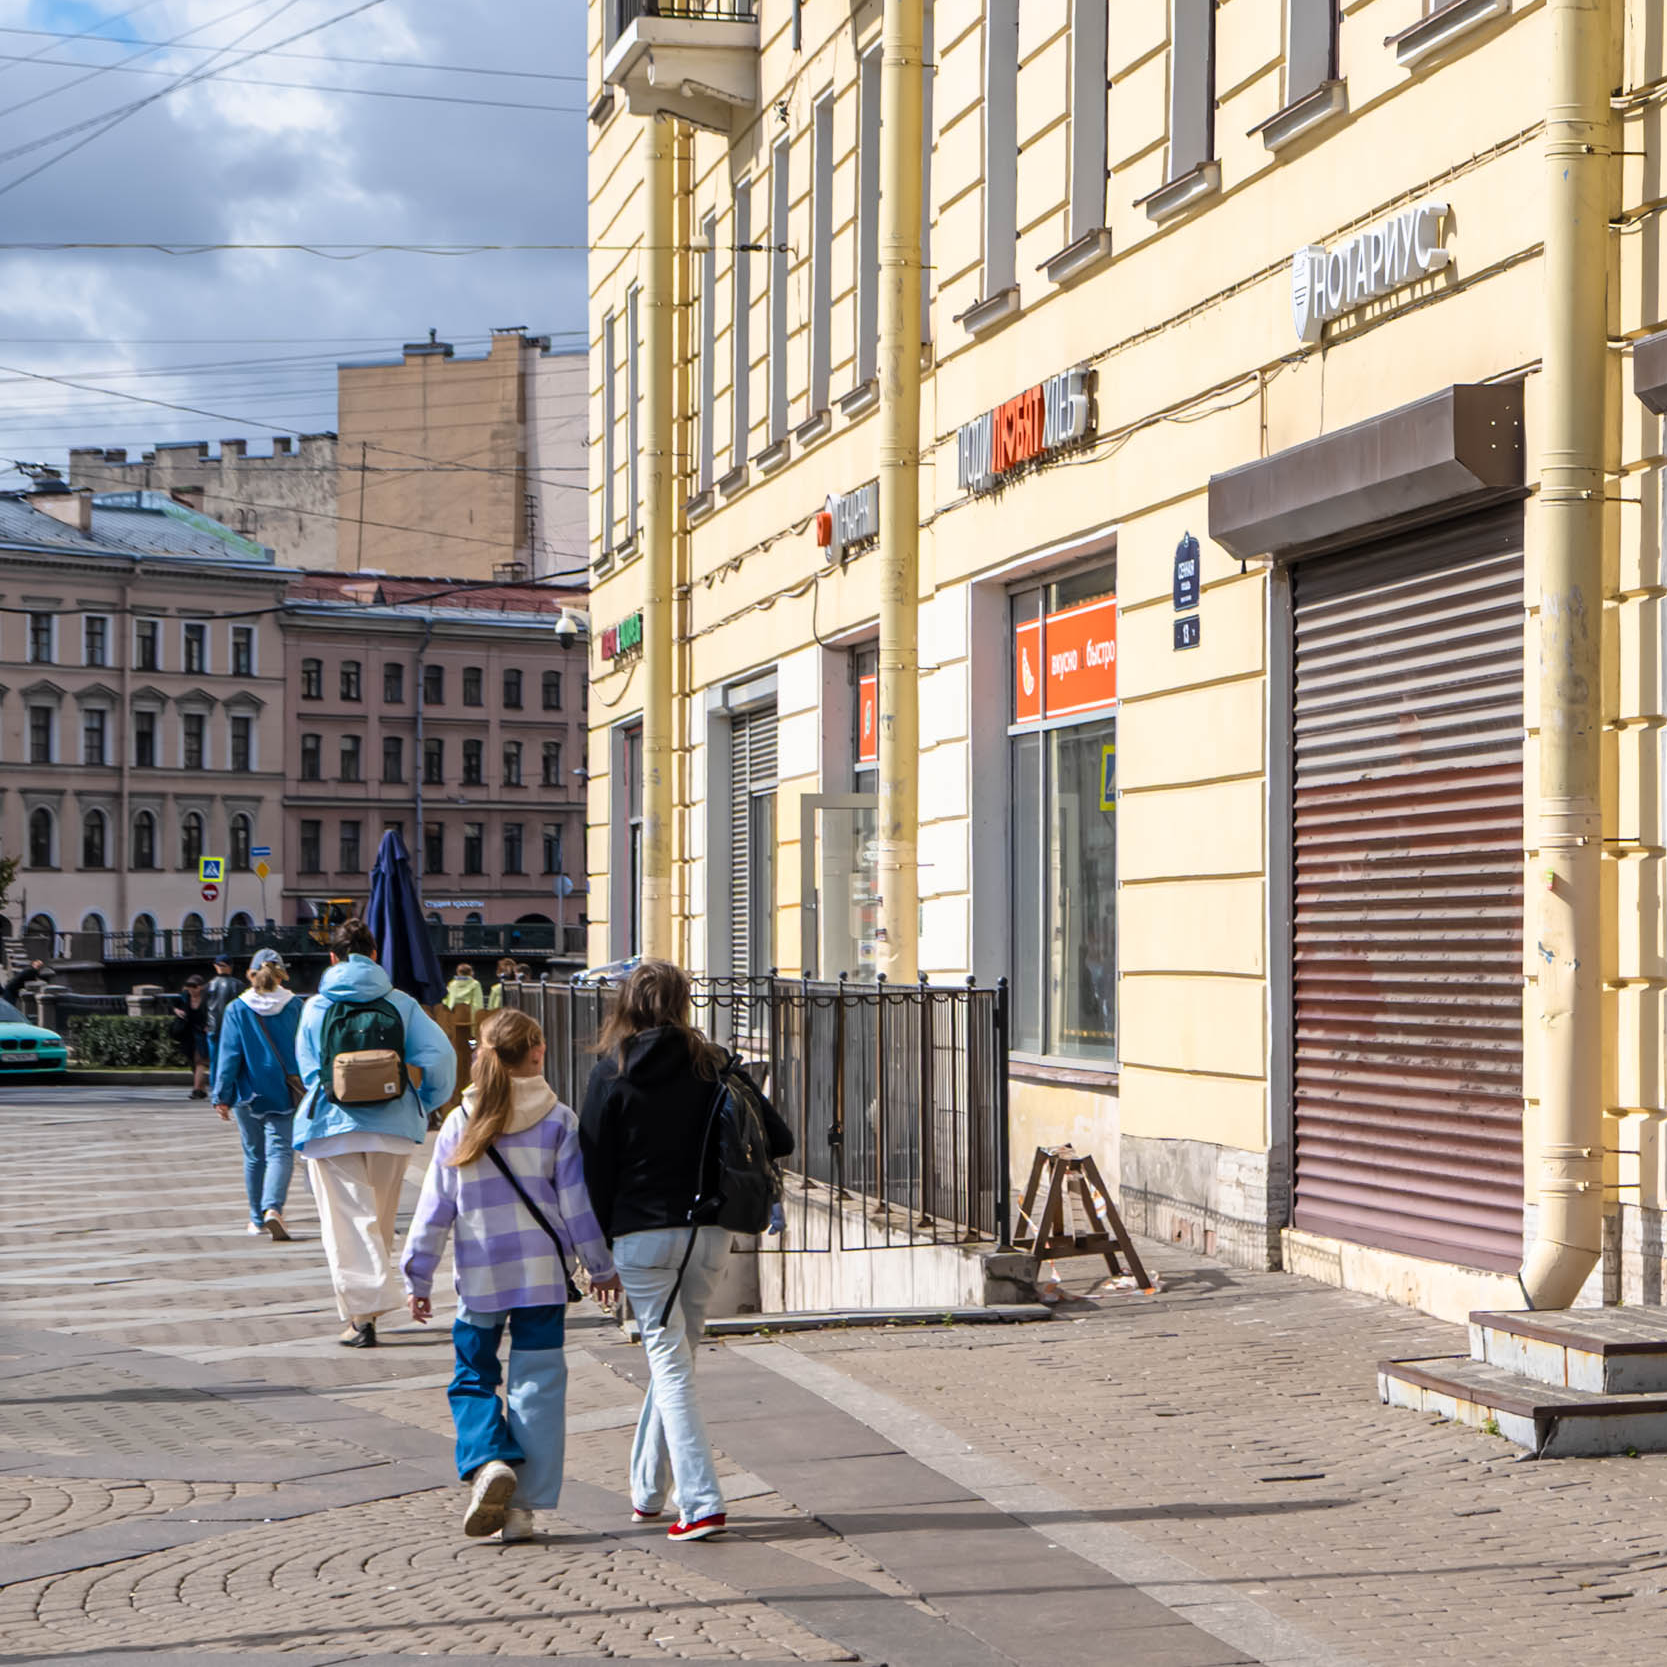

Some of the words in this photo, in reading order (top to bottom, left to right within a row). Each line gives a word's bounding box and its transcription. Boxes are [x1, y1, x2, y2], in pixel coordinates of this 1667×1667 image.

[1313, 202, 1450, 320] НОТАРИУС
[1041, 366, 1089, 449] ХЛЕБ
[1051, 649, 1078, 681] вкусно
[1086, 638, 1115, 670] быстро
